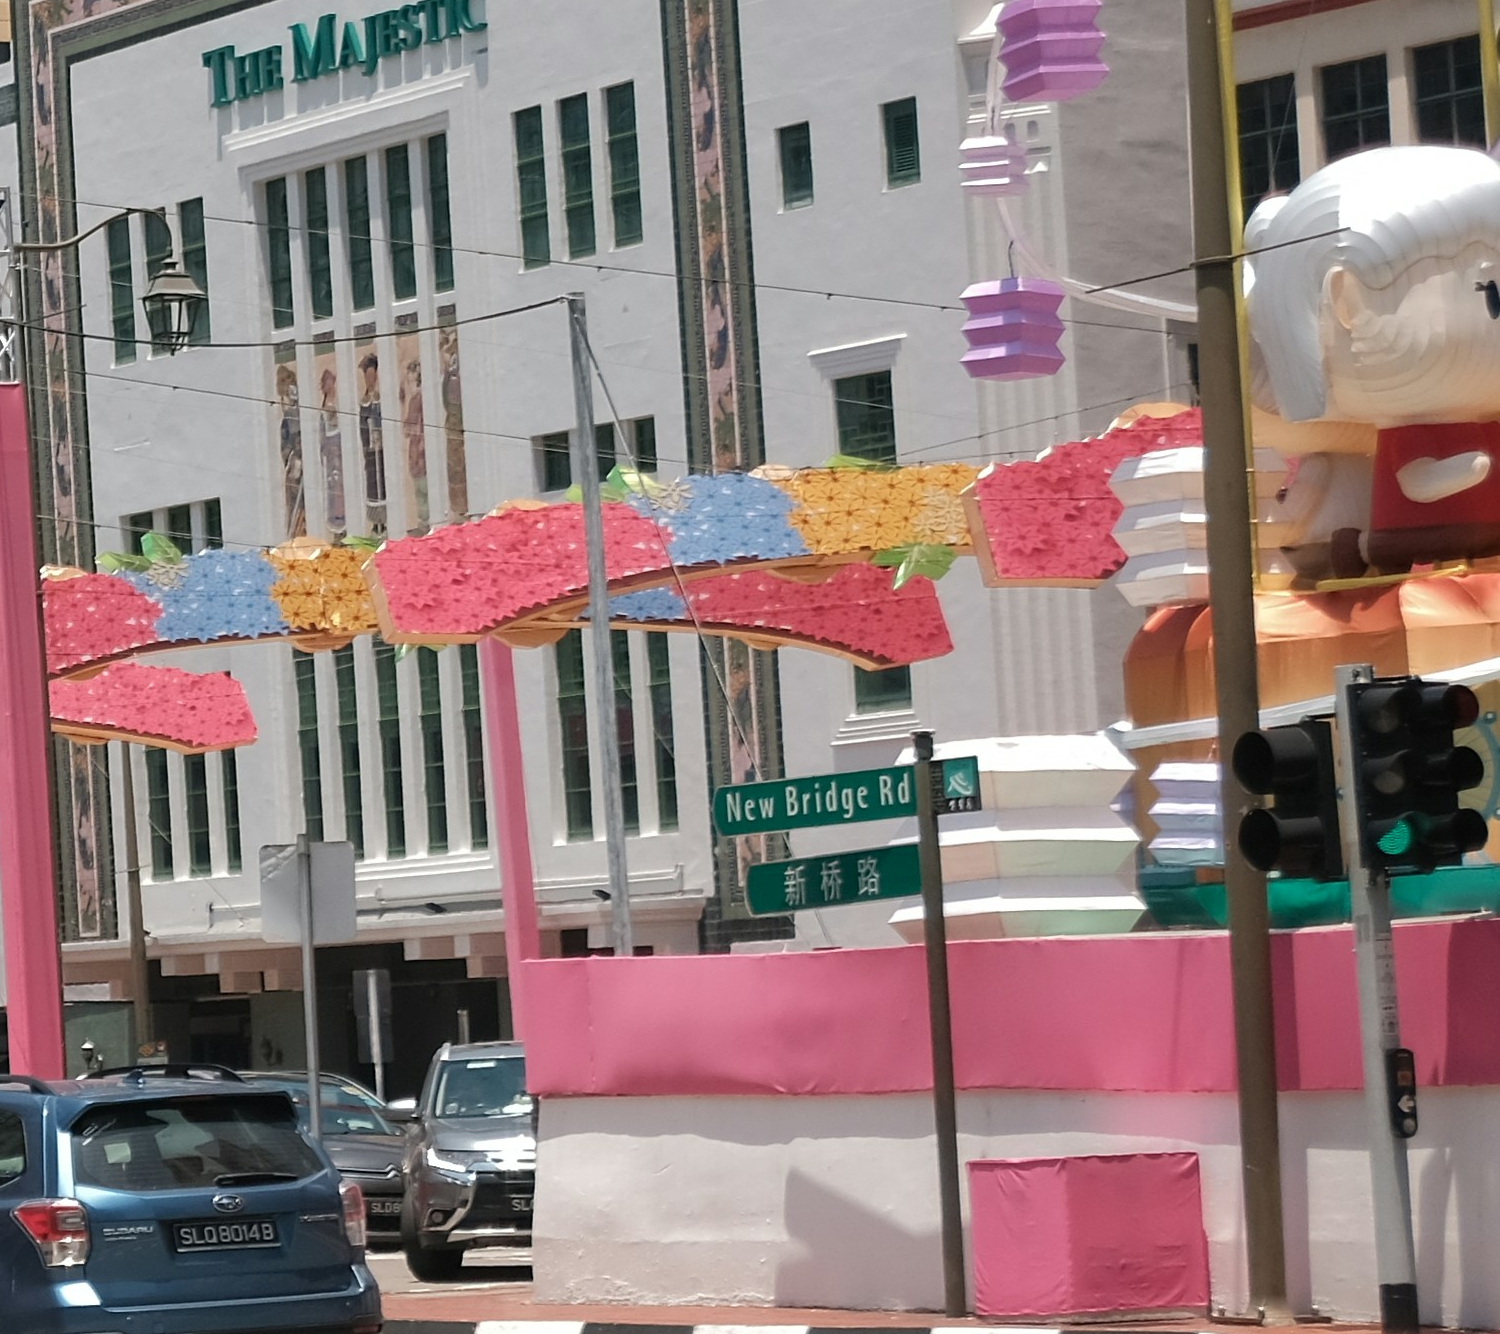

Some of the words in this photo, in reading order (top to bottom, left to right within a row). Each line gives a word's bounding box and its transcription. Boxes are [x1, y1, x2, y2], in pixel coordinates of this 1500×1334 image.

[726, 792, 775, 823] New
[785, 776, 869, 818] Bridge
[879, 772, 911, 806] Rd
[783, 856, 881, 907] 新桥路
[180, 1223, 275, 1246] SLQ8014B
